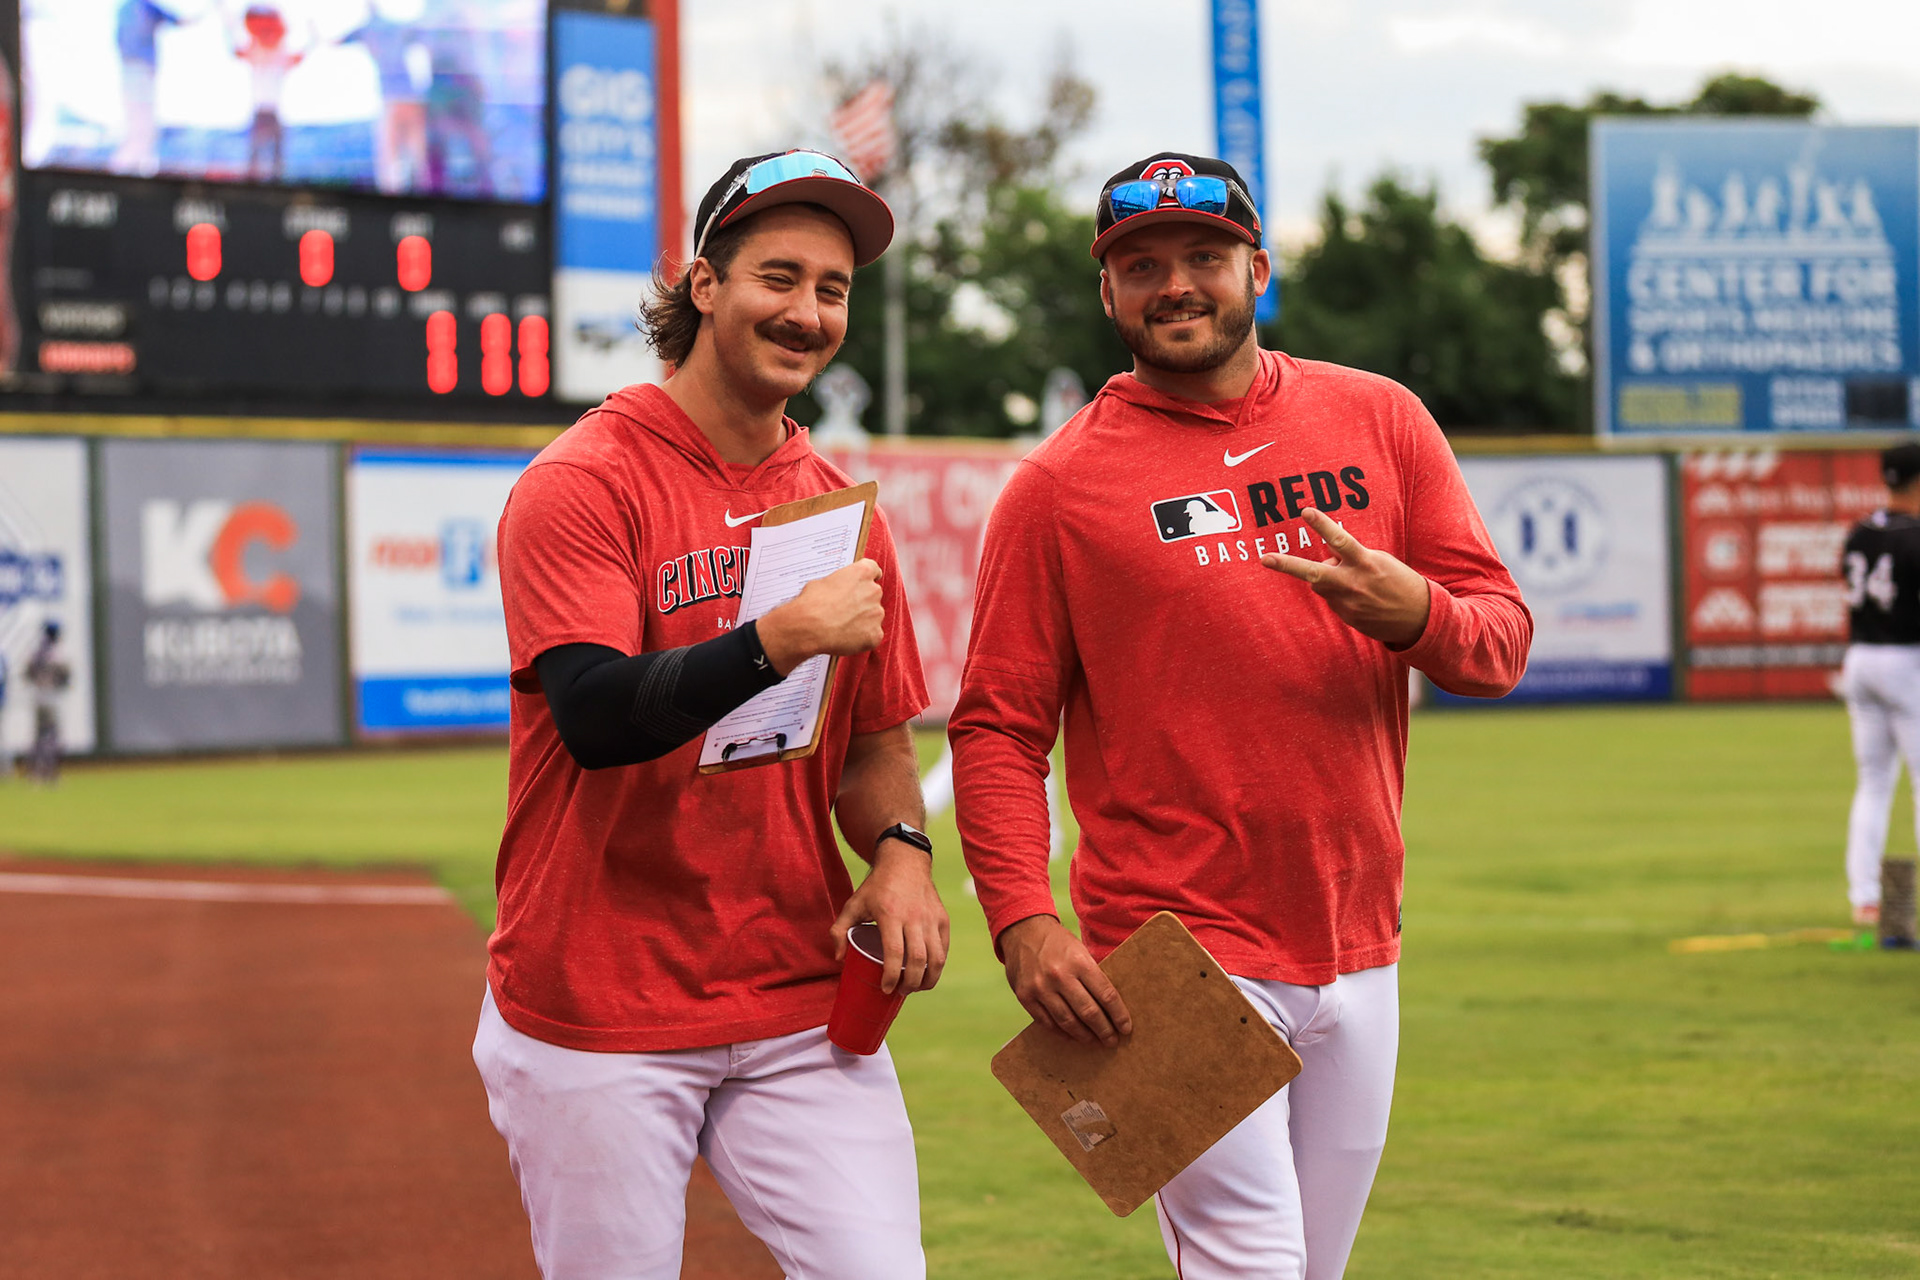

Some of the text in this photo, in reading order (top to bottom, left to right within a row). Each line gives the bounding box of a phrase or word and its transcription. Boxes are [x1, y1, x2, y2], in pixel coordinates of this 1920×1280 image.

[1629, 260, 1895, 300] CENTER FOR
[1247, 466, 1370, 528] REDS
[142, 500, 301, 612] KC
[1195, 521, 1344, 566] BASEBA
[1845, 552, 1898, 611] 34
